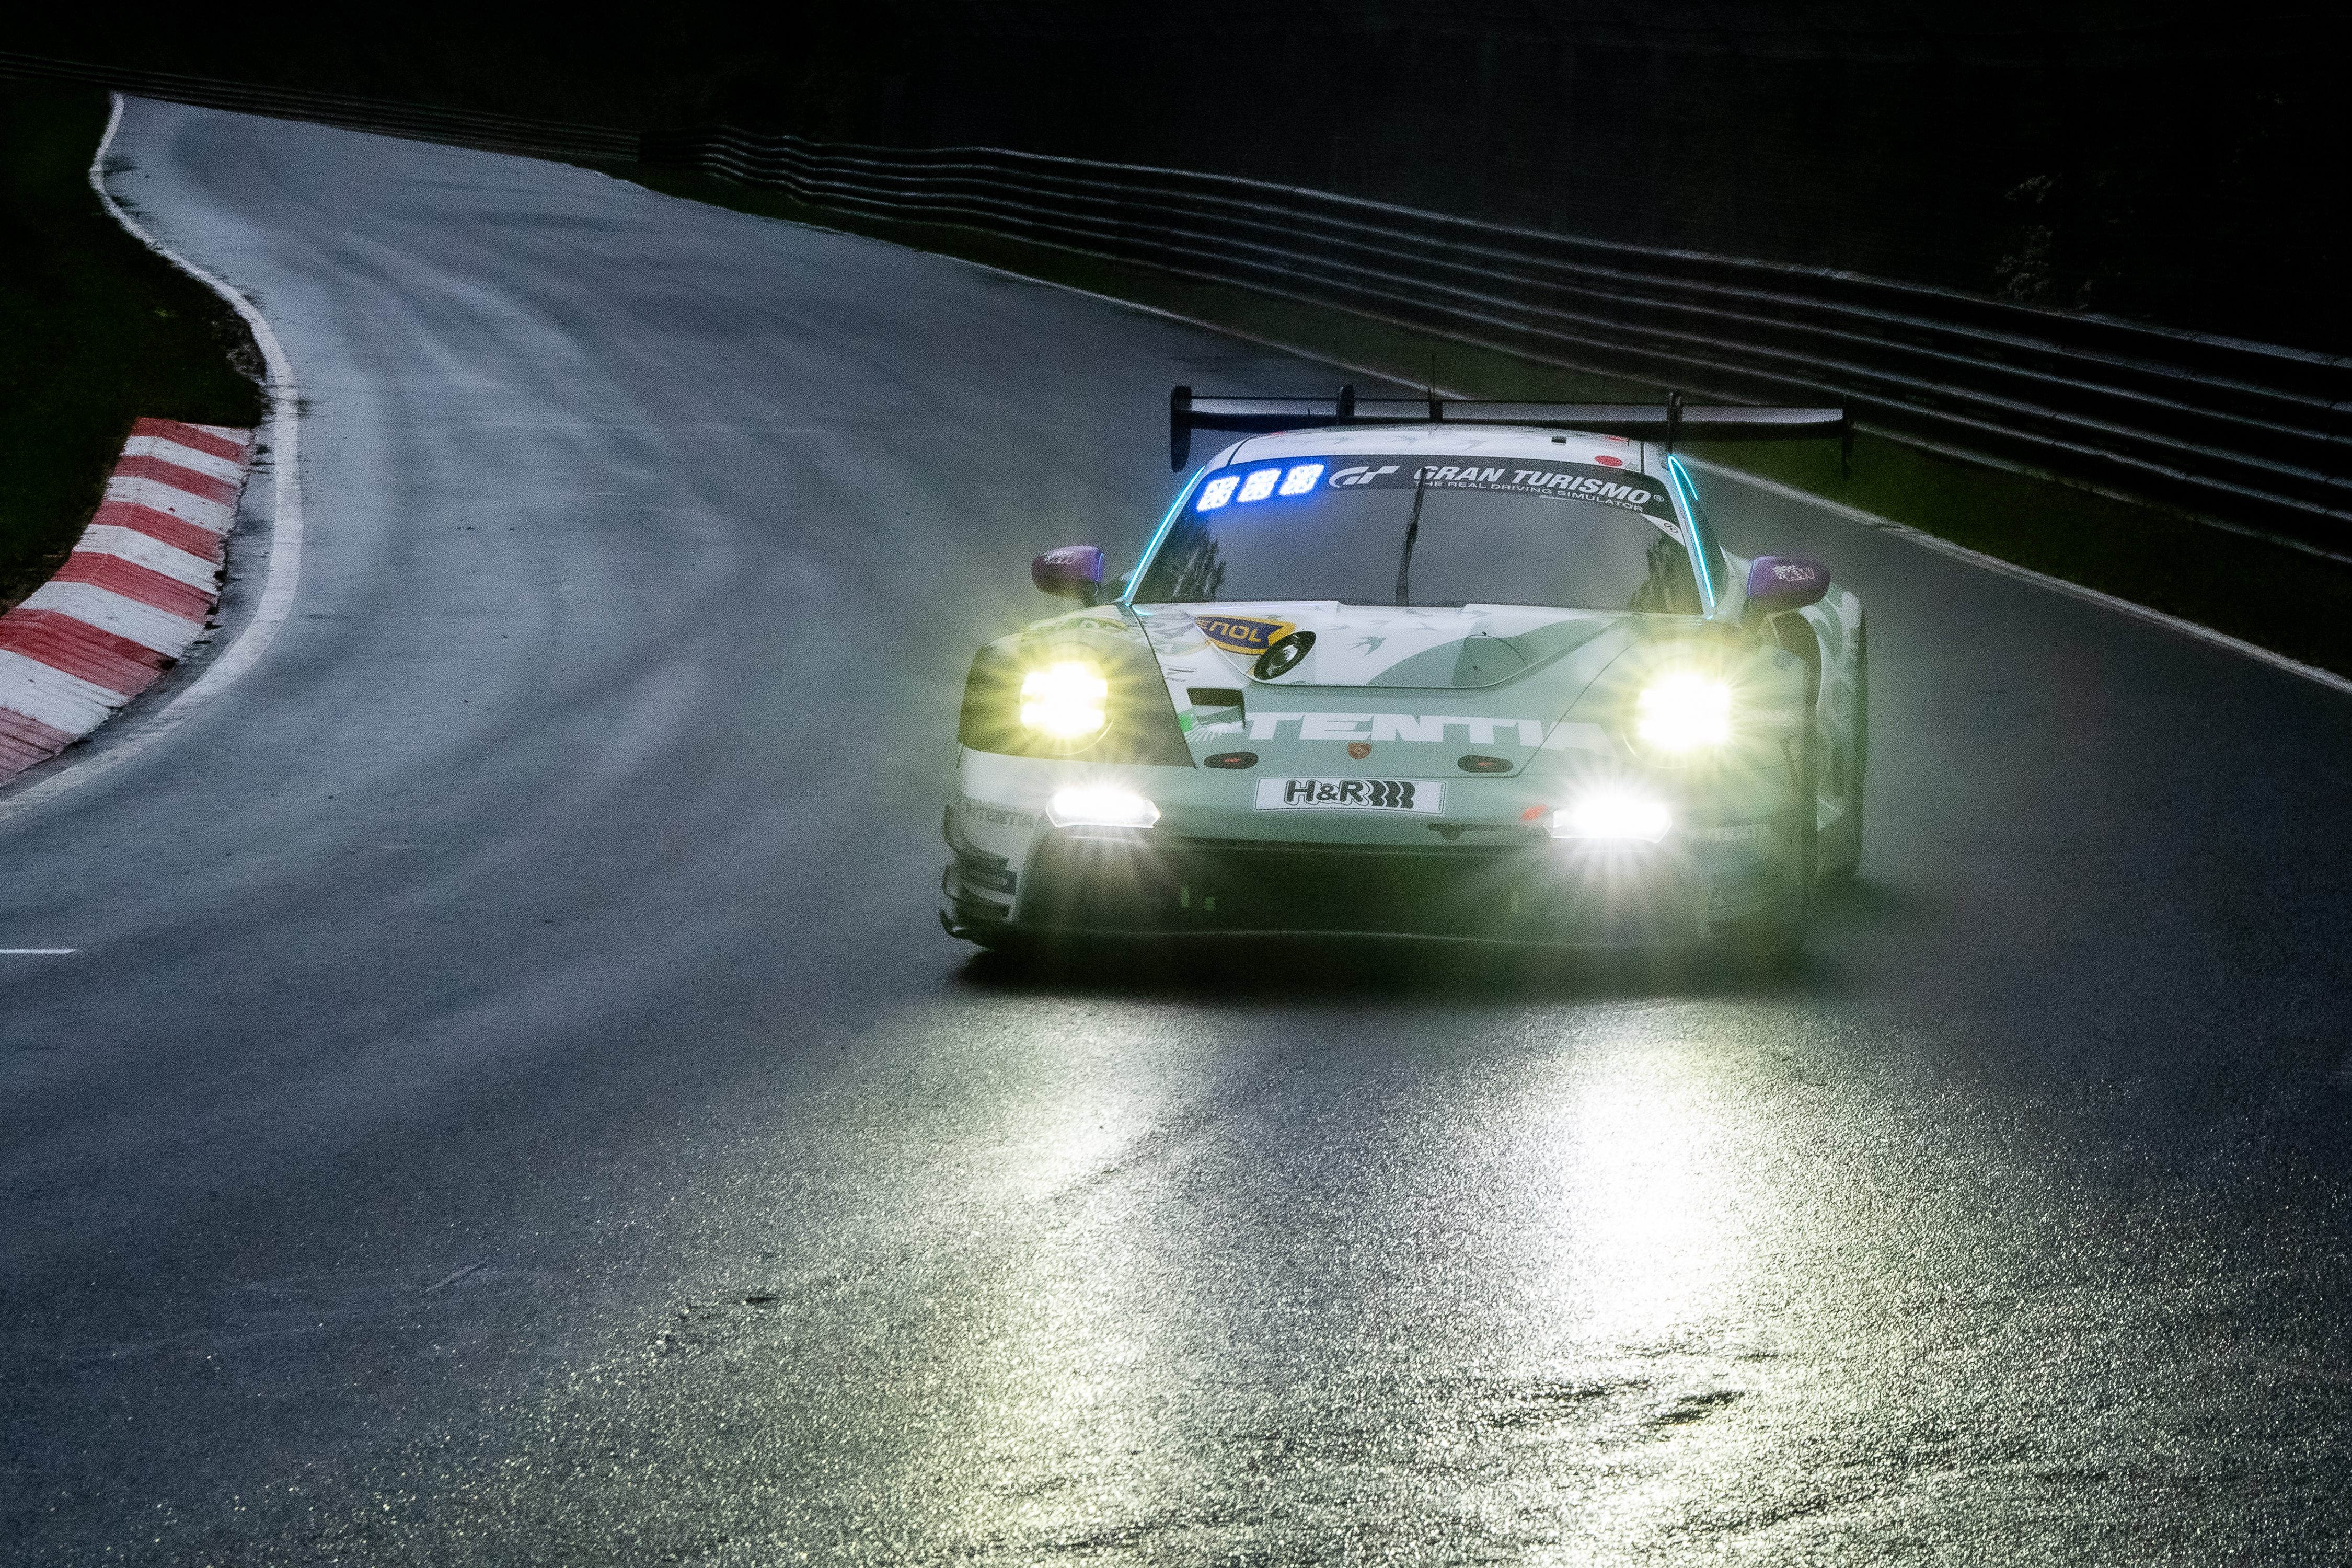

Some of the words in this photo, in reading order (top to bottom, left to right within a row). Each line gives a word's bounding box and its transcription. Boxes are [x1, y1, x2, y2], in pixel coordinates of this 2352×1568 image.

[1413, 466, 1506, 482] GRAN
[1491, 483, 1552, 494] DRIVING
[1558, 489, 1643, 512] SIMULATOR
[1285, 780, 1364, 803] H&R
